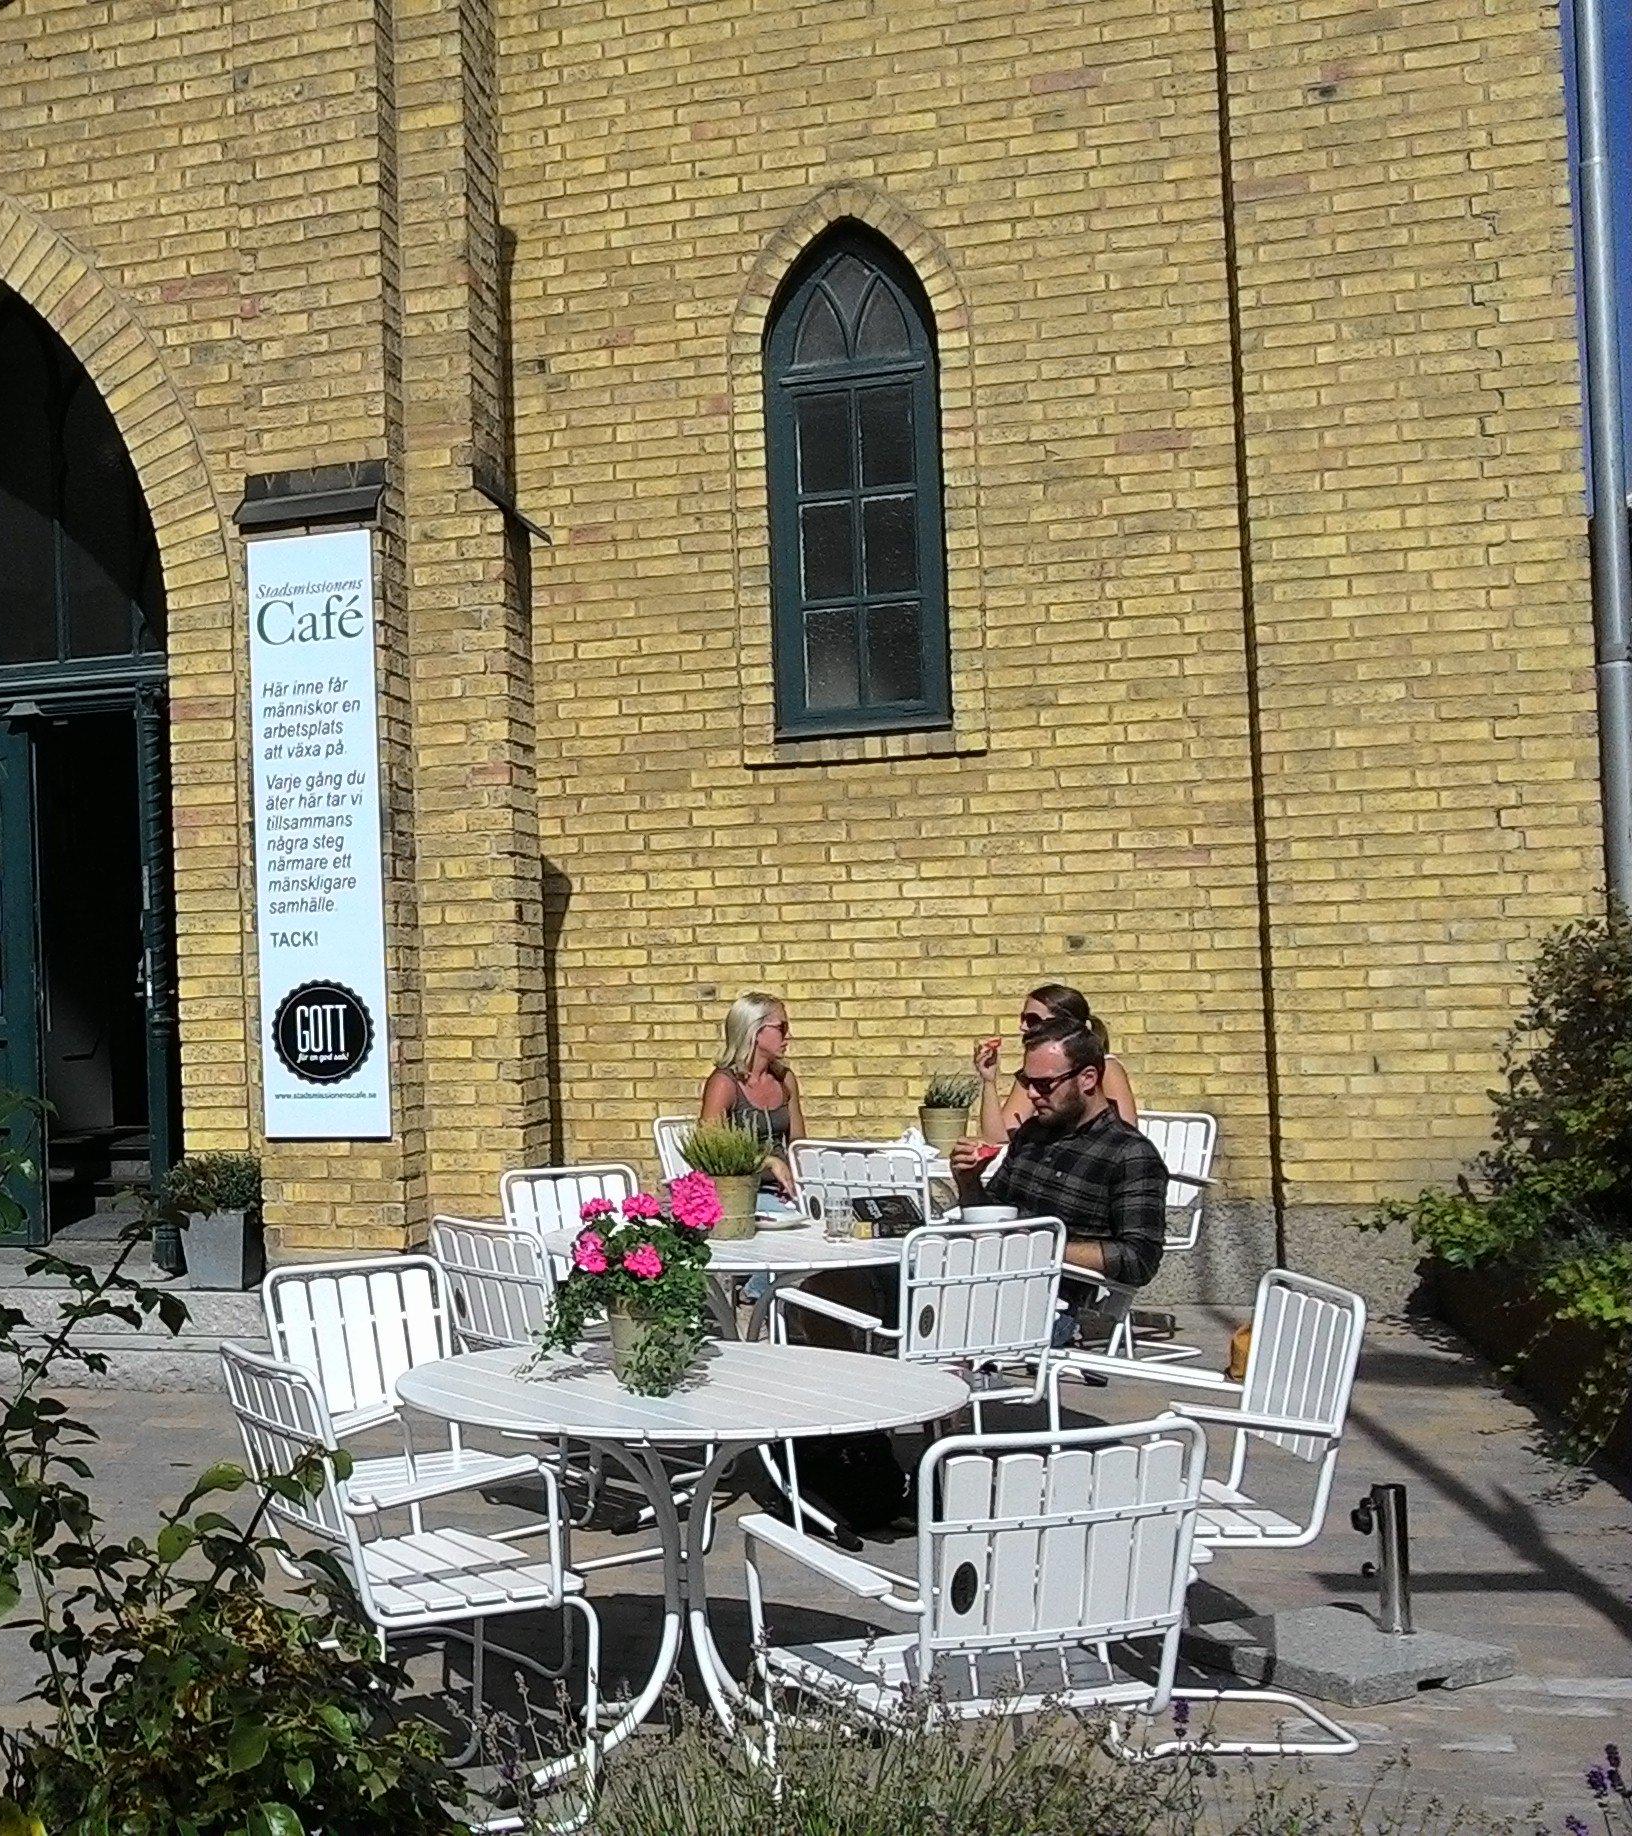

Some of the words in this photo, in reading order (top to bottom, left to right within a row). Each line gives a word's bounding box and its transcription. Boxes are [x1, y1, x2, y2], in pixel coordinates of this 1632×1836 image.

[256, 579, 363, 599] Stadsmissionens
[257, 594, 364, 645] Café
[262, 681, 289, 698] Här
[293, 679, 324, 696] inne
[328, 676, 348, 693] får
[263, 699, 338, 718] människor
[342, 699, 361, 713] en
[263, 720, 344, 740] arbetsplats
[264, 745, 283, 760] att
[287, 743, 321, 758] växa
[266, 773, 302, 793] Varje
[306, 771, 343, 792] gång
[347, 769, 366, 786] du
[266, 793, 294, 811] äter
[298, 791, 322, 808] här
[326, 791, 347, 807] tar
[351, 789, 363, 806] vi
[266, 814, 353, 831] tillsammans
[267, 835, 308, 855] några
[313, 835, 345, 852] steg
[268, 856, 328, 872] närmare
[332, 854, 352, 869] ett
[268, 875, 357, 894] mänskligare
[270, 930, 319, 948] TACK!
[296, 1005, 347, 1052] GOTT
